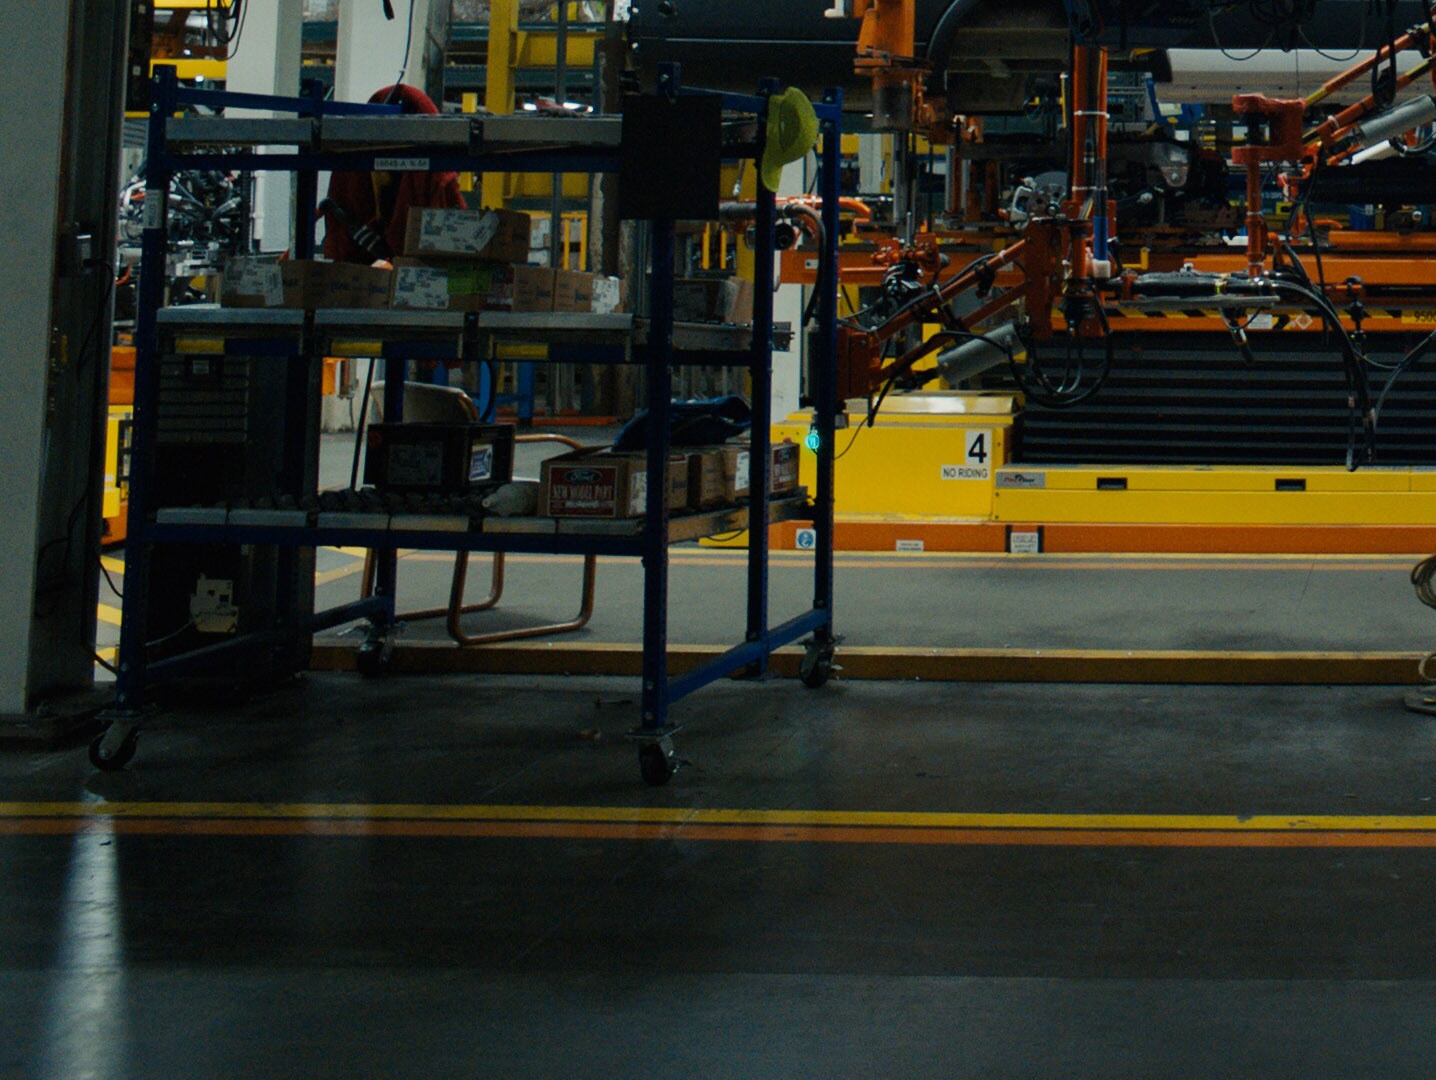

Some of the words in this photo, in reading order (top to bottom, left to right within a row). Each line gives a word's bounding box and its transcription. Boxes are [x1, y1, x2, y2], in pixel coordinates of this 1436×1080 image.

[968, 433, 987, 463] 4
[942, 468, 957, 478] NO
[958, 468, 988, 478] RIDING
